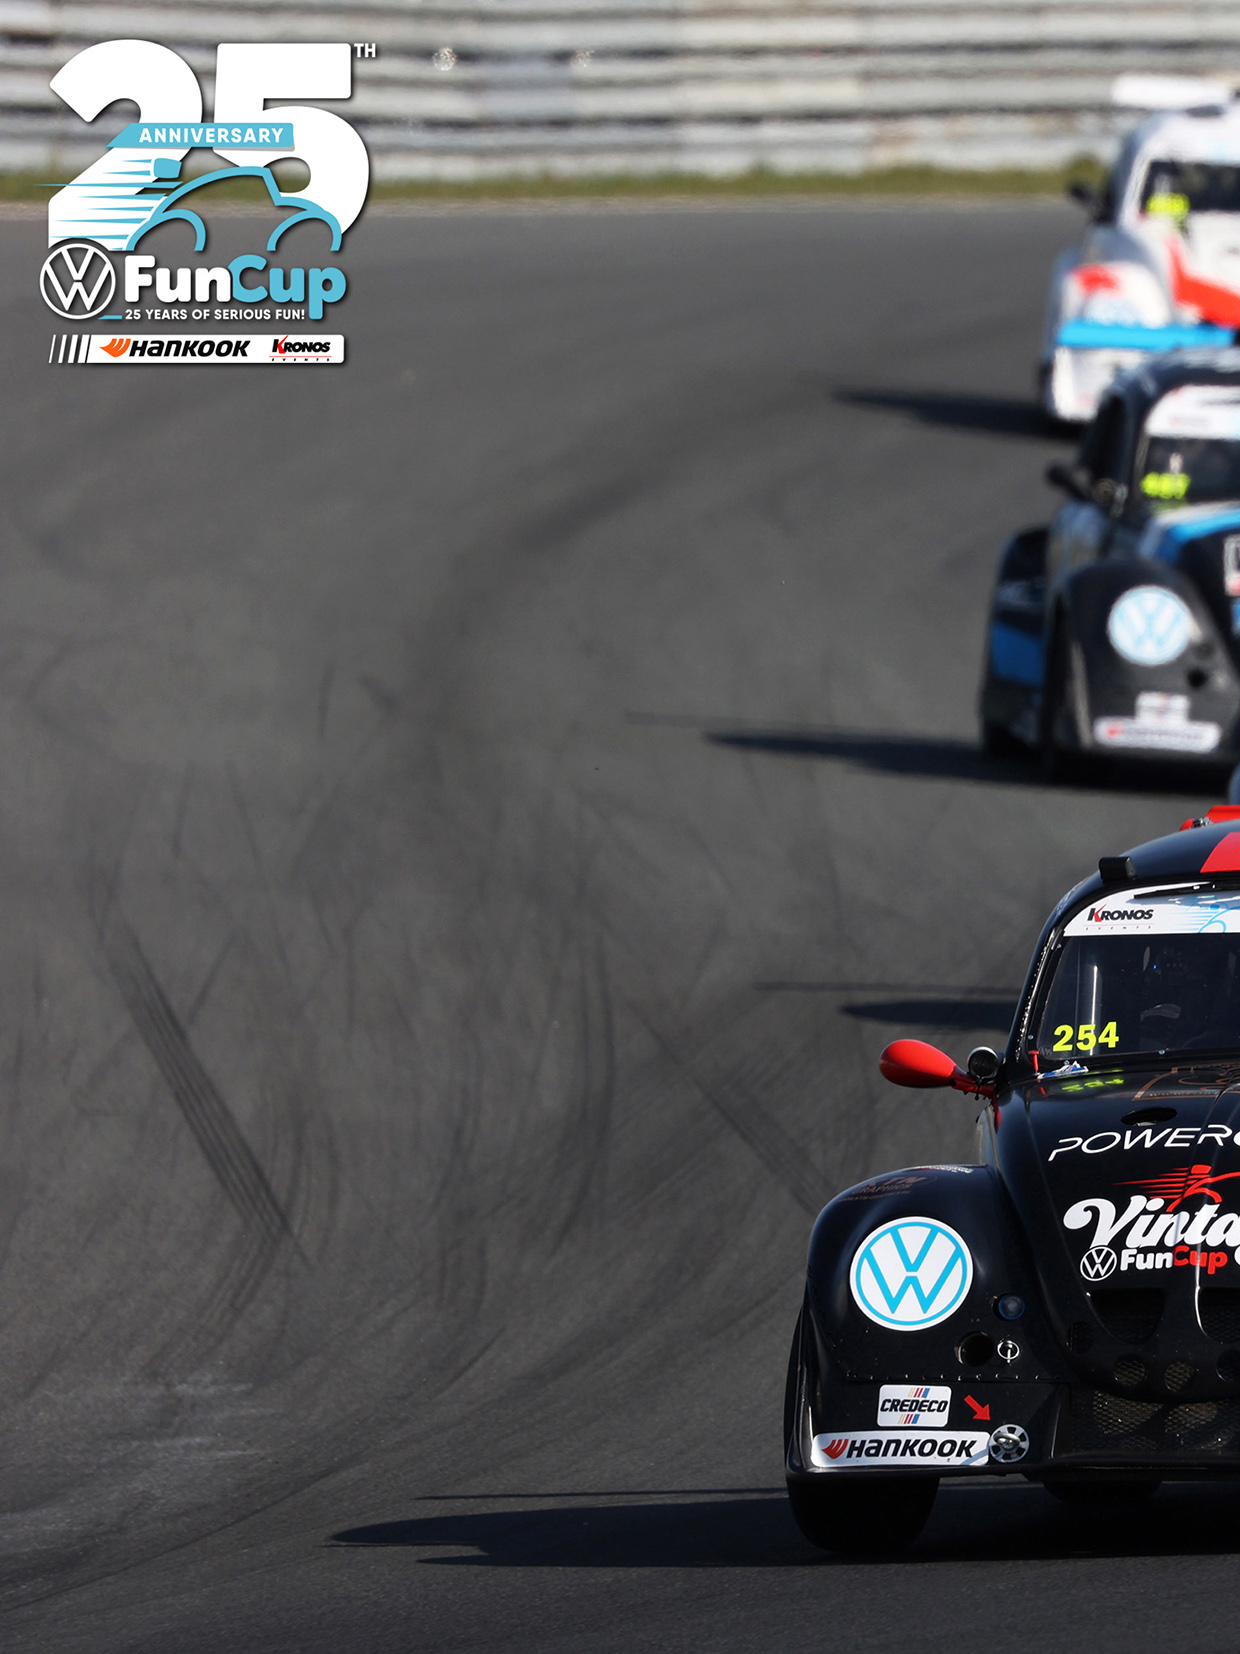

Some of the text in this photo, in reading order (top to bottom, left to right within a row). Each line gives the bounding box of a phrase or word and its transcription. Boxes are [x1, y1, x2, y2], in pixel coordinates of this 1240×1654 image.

[1087, 904, 1154, 922] KRONOS
[1052, 1021, 1119, 1051] 254
[1120, 1245, 1228, 1274] FunCup
[880, 1398, 948, 1413] CREDECO
